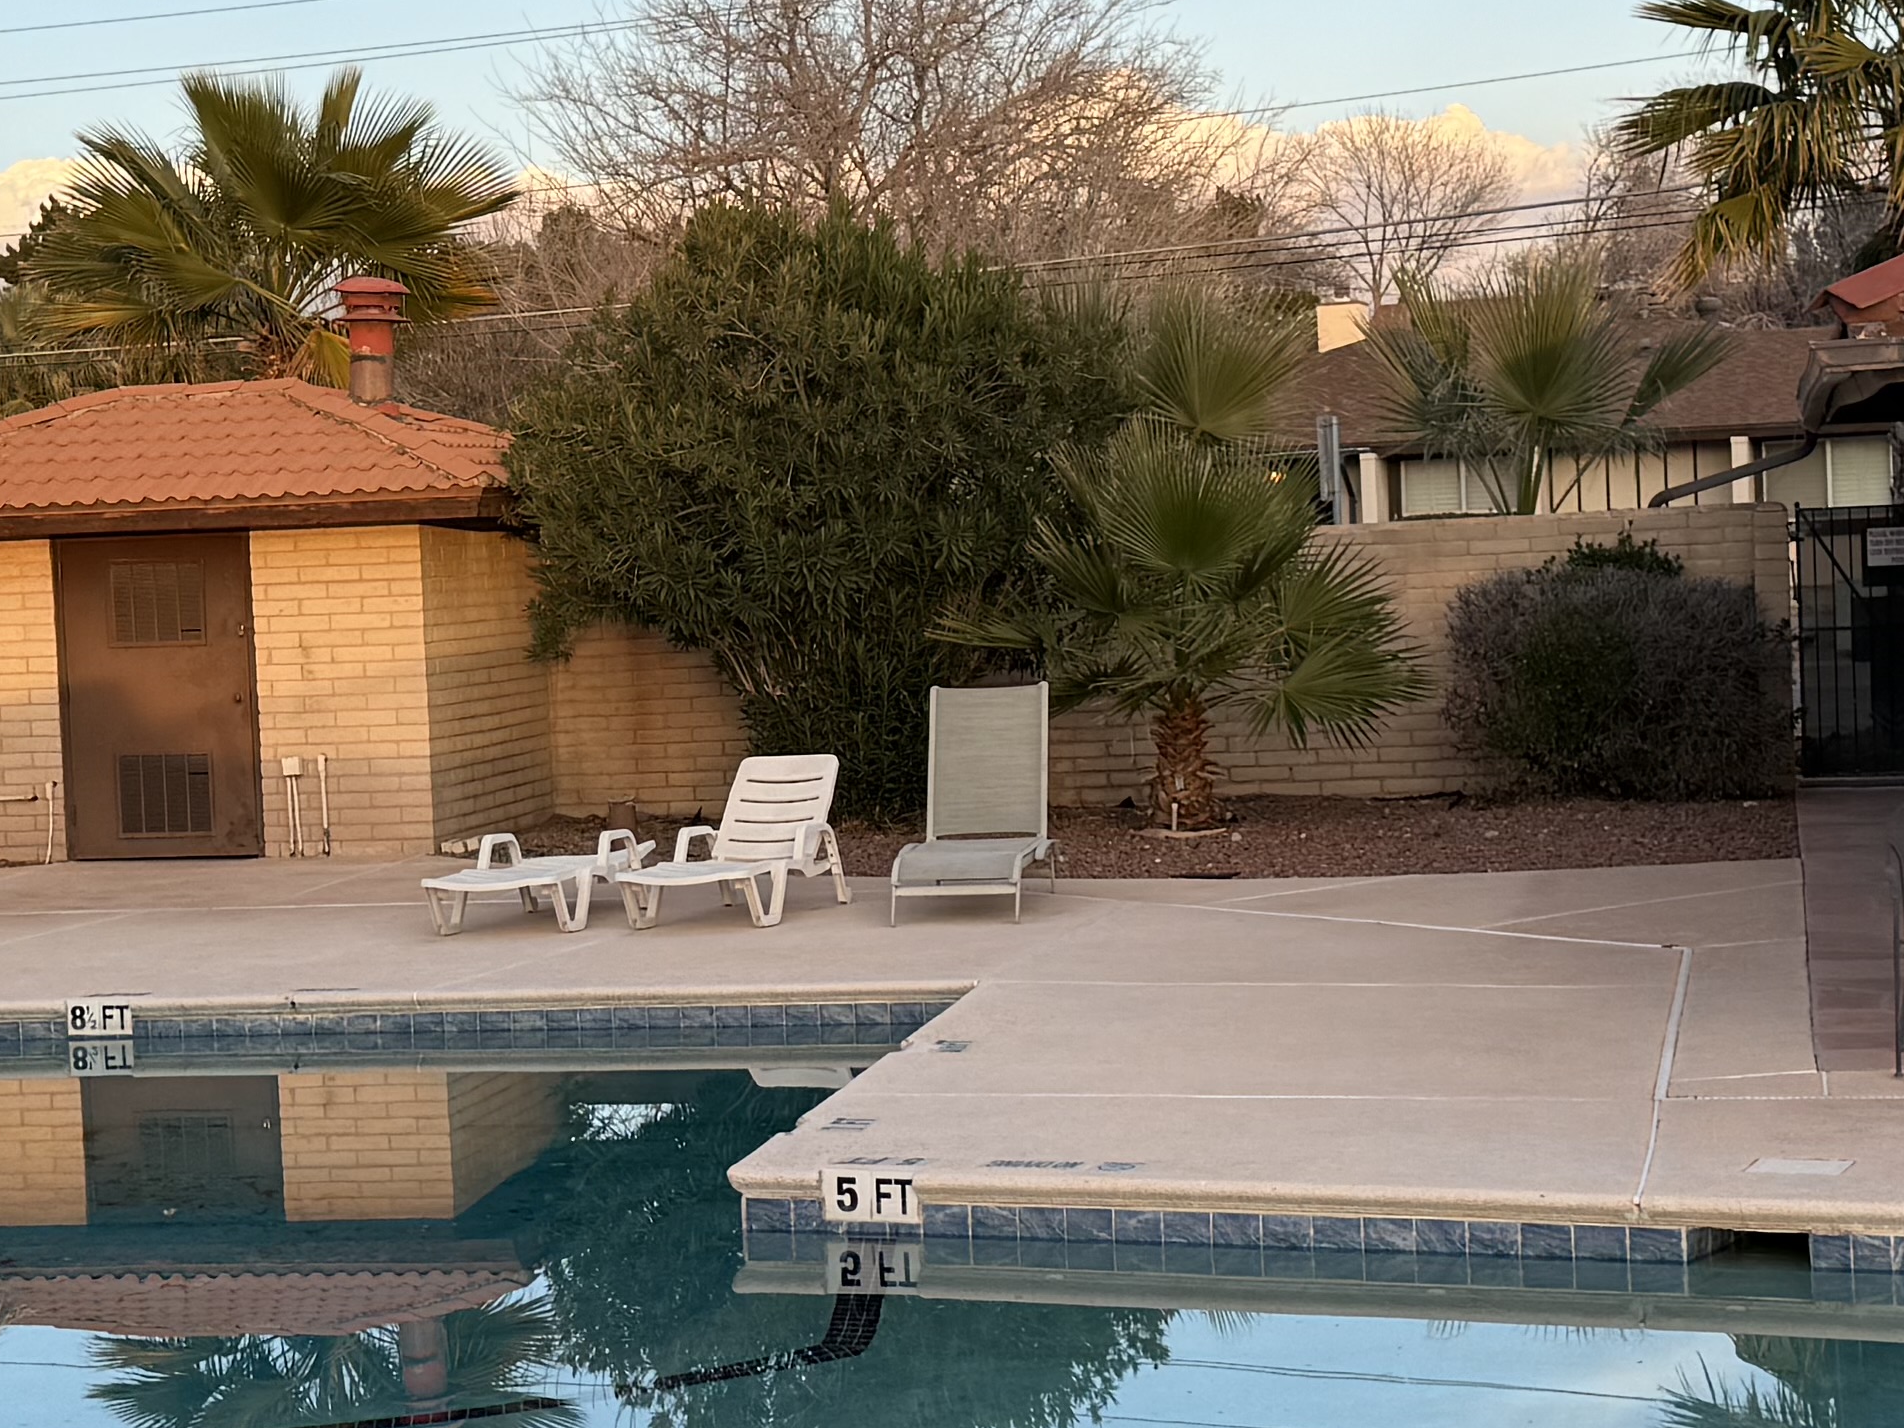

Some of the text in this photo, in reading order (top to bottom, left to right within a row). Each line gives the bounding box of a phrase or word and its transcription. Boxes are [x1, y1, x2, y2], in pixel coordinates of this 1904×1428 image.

[102, 1005, 129, 1030] FT
[836, 1177, 912, 1215] 5 FT
